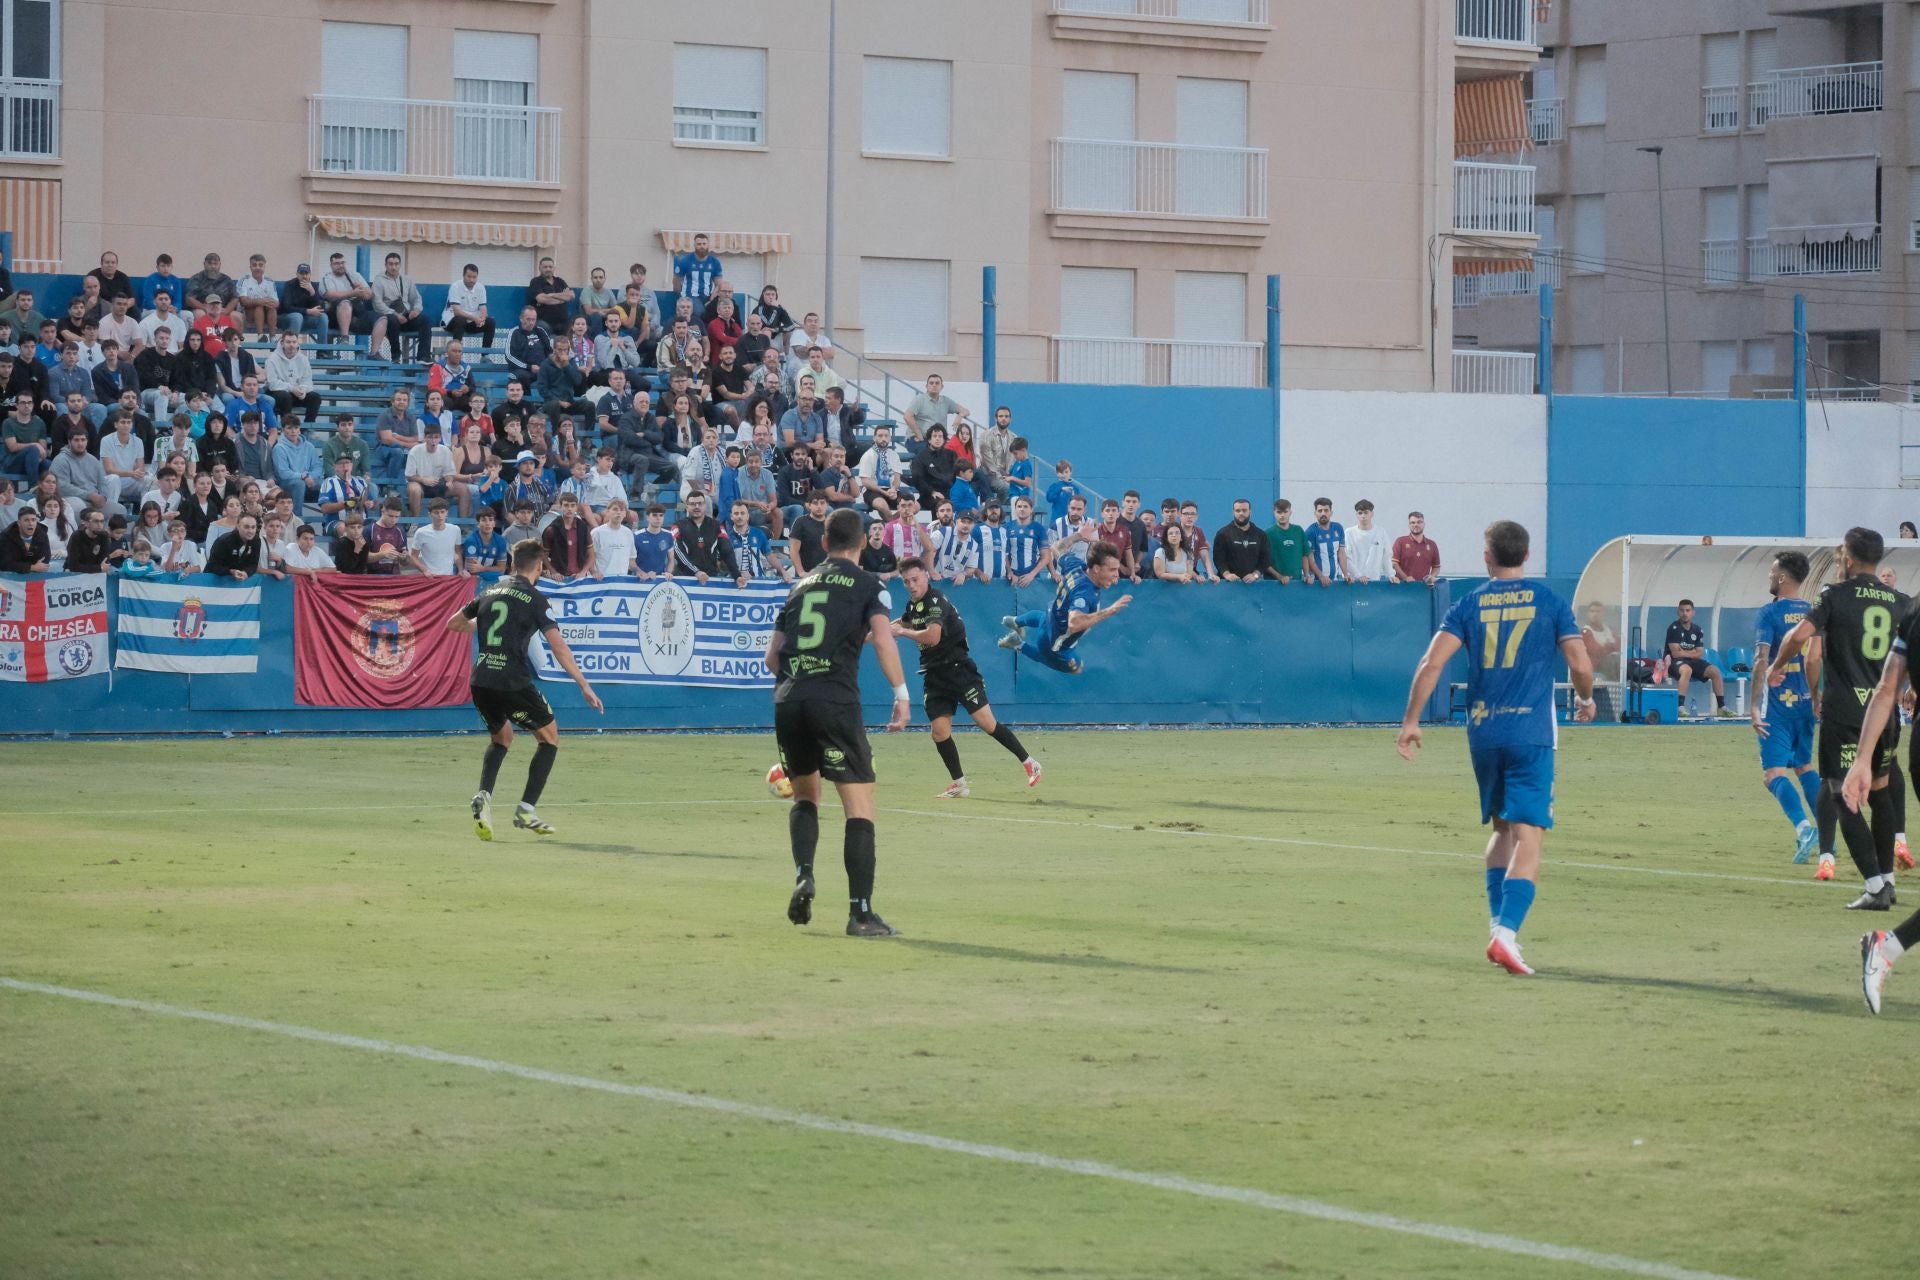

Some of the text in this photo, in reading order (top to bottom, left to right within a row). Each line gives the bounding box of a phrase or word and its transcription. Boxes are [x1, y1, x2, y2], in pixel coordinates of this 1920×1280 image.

[825, 574, 855, 587] CANO
[47, 586, 105, 608] LORCA
[501, 588, 532, 604] HURTADO
[1855, 587, 1896, 603] ZARFINO
[27, 618, 97, 642] CHELSEA
[486, 600, 509, 646] 2
[797, 591, 829, 650] 5
[561, 625, 595, 639] scala
[1480, 606, 1537, 669] 17
[1861, 605, 1892, 661] 8
[654, 643, 678, 656] XII
